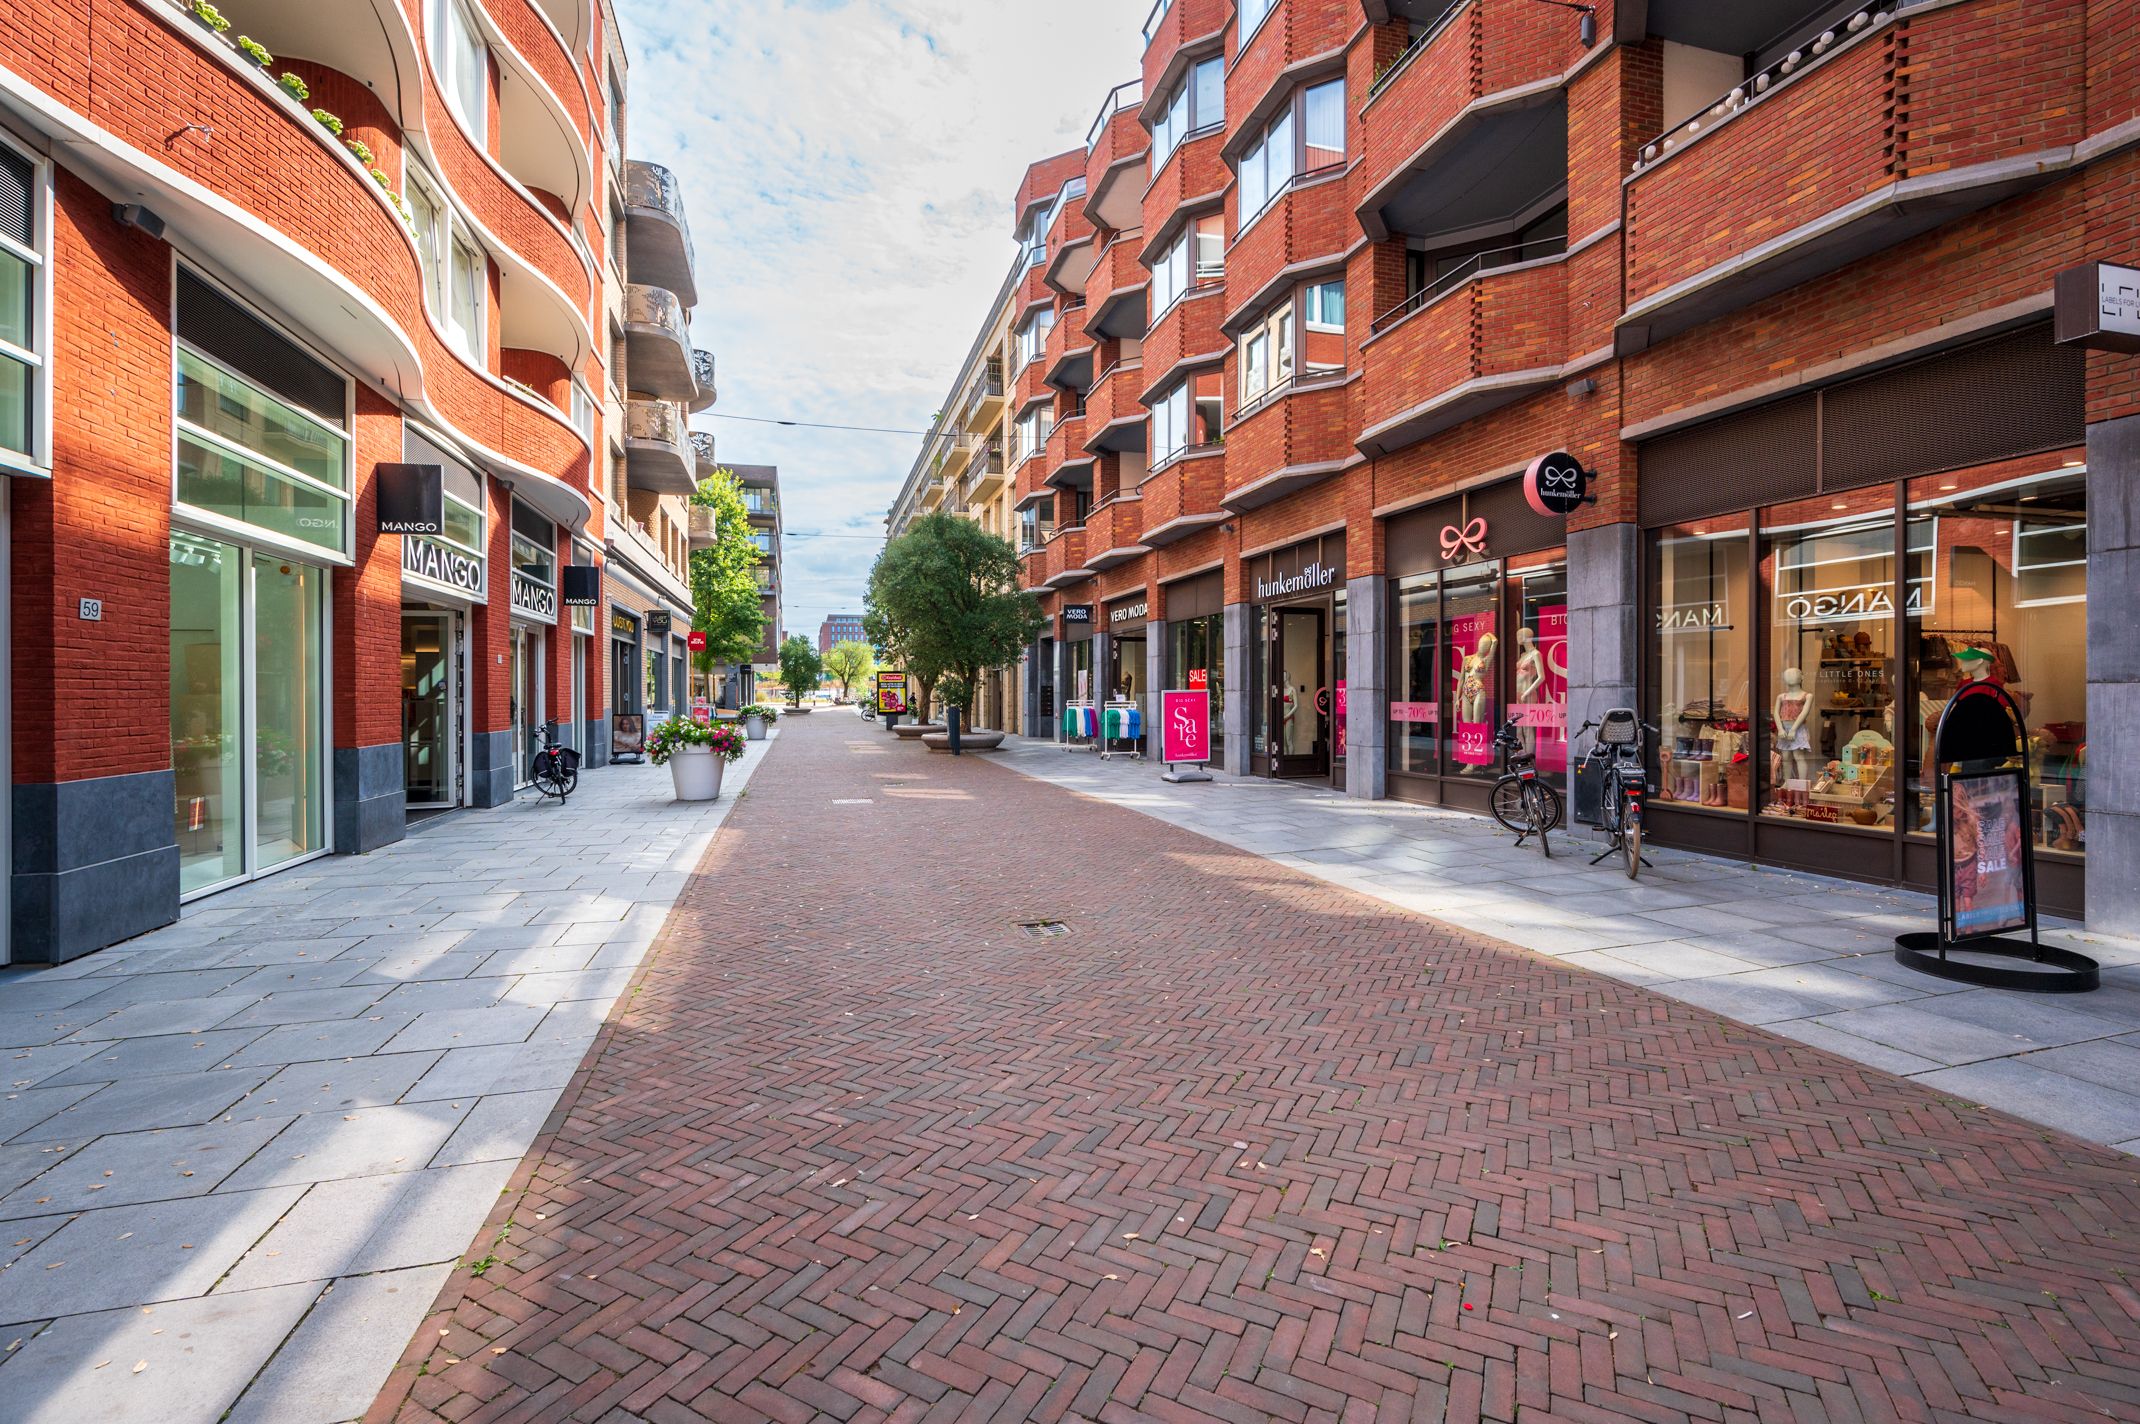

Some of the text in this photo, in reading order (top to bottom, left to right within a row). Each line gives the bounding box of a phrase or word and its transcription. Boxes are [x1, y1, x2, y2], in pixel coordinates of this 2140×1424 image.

[381, 521, 437, 532] MANGO
[407, 535, 481, 591] MANGO
[512, 577, 554, 616] MANGO
[565, 598, 597, 606] MANGO
[83, 601, 99, 618] 59
[1110, 602, 1148, 623] VERO MODA
[1462, 621, 1485, 632] SEXY
[1189, 669, 1207, 683] SALE
[1819, 669, 1885, 678] LITTLE ONES
[1977, 857, 2007, 874] SALE
